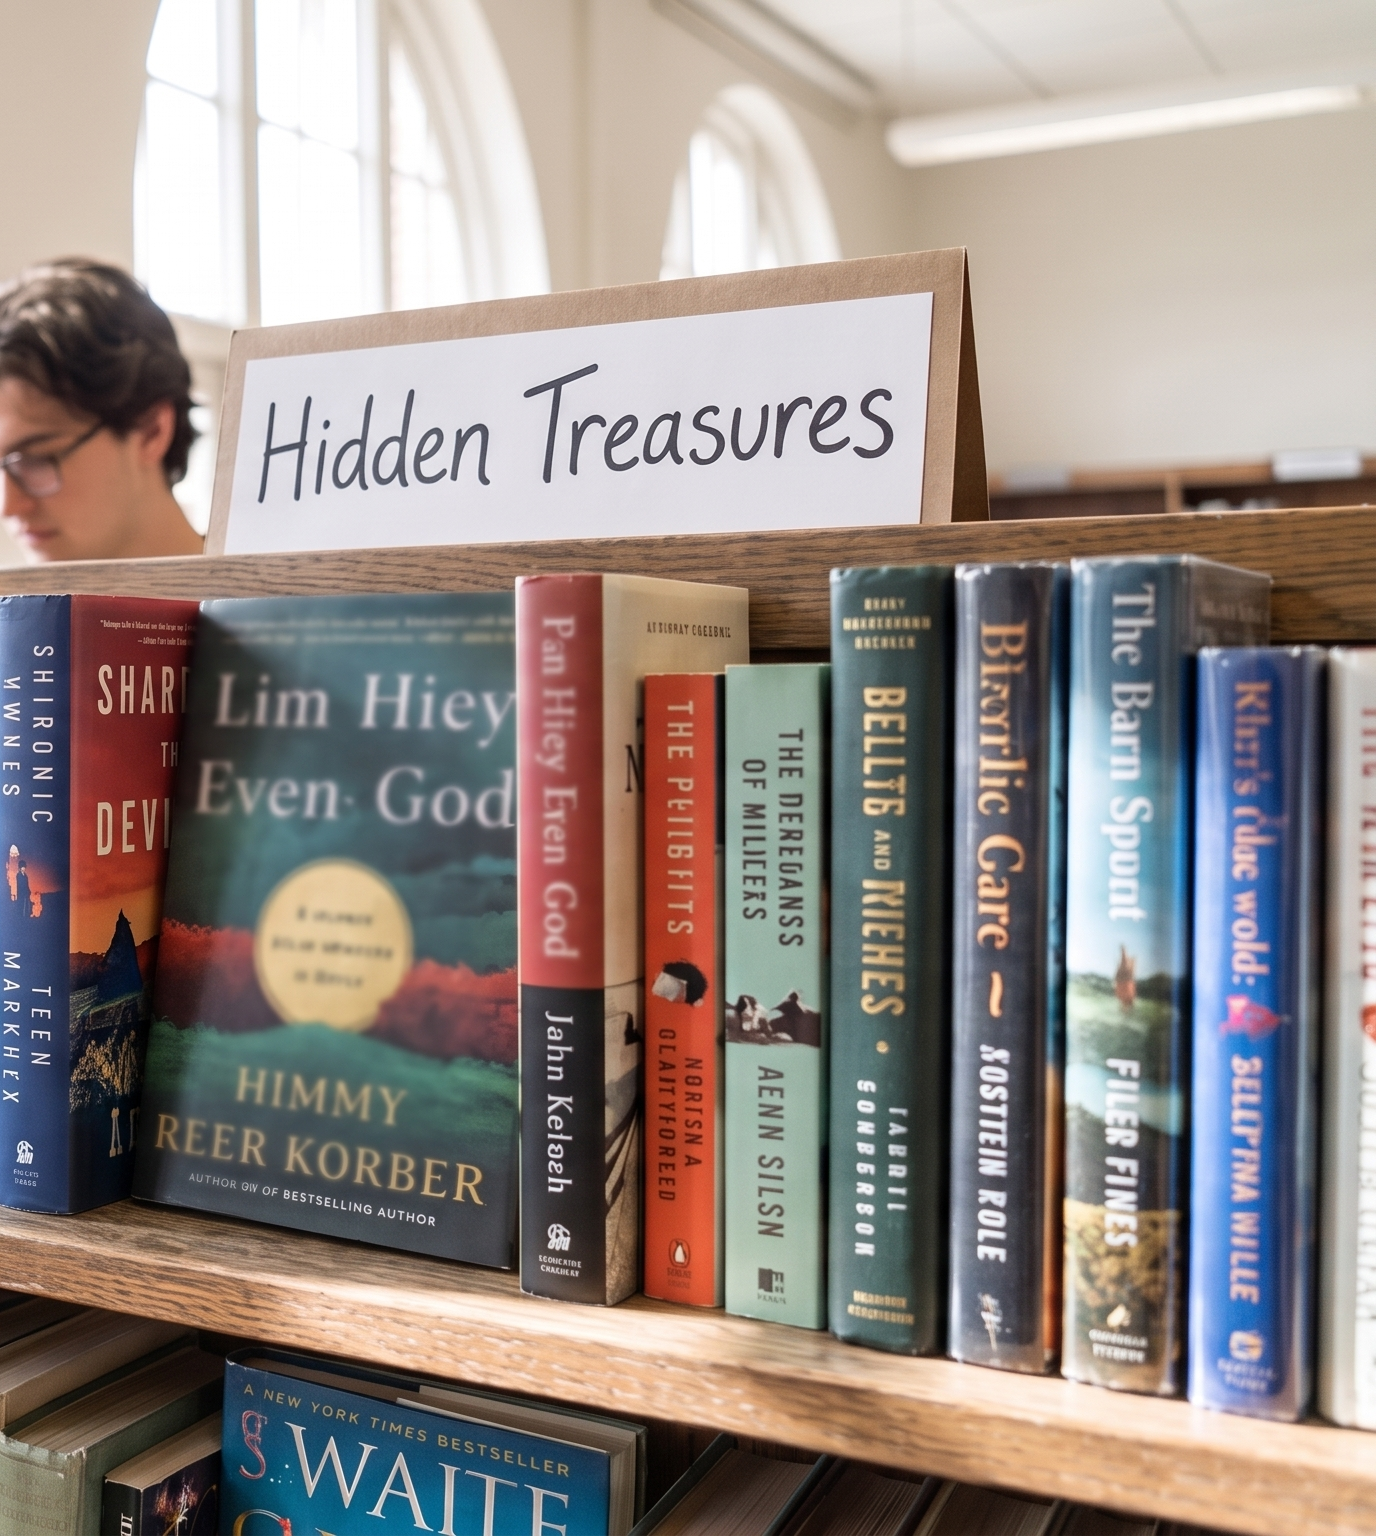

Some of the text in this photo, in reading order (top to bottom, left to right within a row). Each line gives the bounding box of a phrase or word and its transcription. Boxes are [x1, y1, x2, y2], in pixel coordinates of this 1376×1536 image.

[258, 363, 894, 504] Hidden Treasures
[1111, 582, 1157, 667] The
[31, 645, 55, 823] SHIRONIC
[215, 672, 517, 749] Lim Hiey
[666, 701, 695, 759] THE
[1110, 680, 1154, 782] Barn
[741, 759, 767, 790] OF
[778, 728, 804, 779] THE
[376, 764, 517, 829] God
[873, 829, 892, 871] AND
[542, 880, 580, 960] God
[976, 834, 1025, 951] Care
[31, 985, 52, 1066] TEEN
[544, 1010, 574, 1082] Jahn
[235, 1064, 409, 1128] HIMMY
[757, 1065, 785, 1142] AENN
[154, 1113, 268, 1168] REER
[284, 1134, 486, 1207] KORBER
[1103, 1057, 1141, 1249] FILER FINES
[188, 1171, 238, 1191] AUTHOR
[262, 1186, 280, 1198] OF
[282, 1188, 374, 1216] BESTSELLING
[377, 1206, 437, 1228] AUTHOR
[757, 1154, 785, 1238] SILSN
[244, 1384, 571, 1478] A NEW YORK TIMES BESTSELLER
